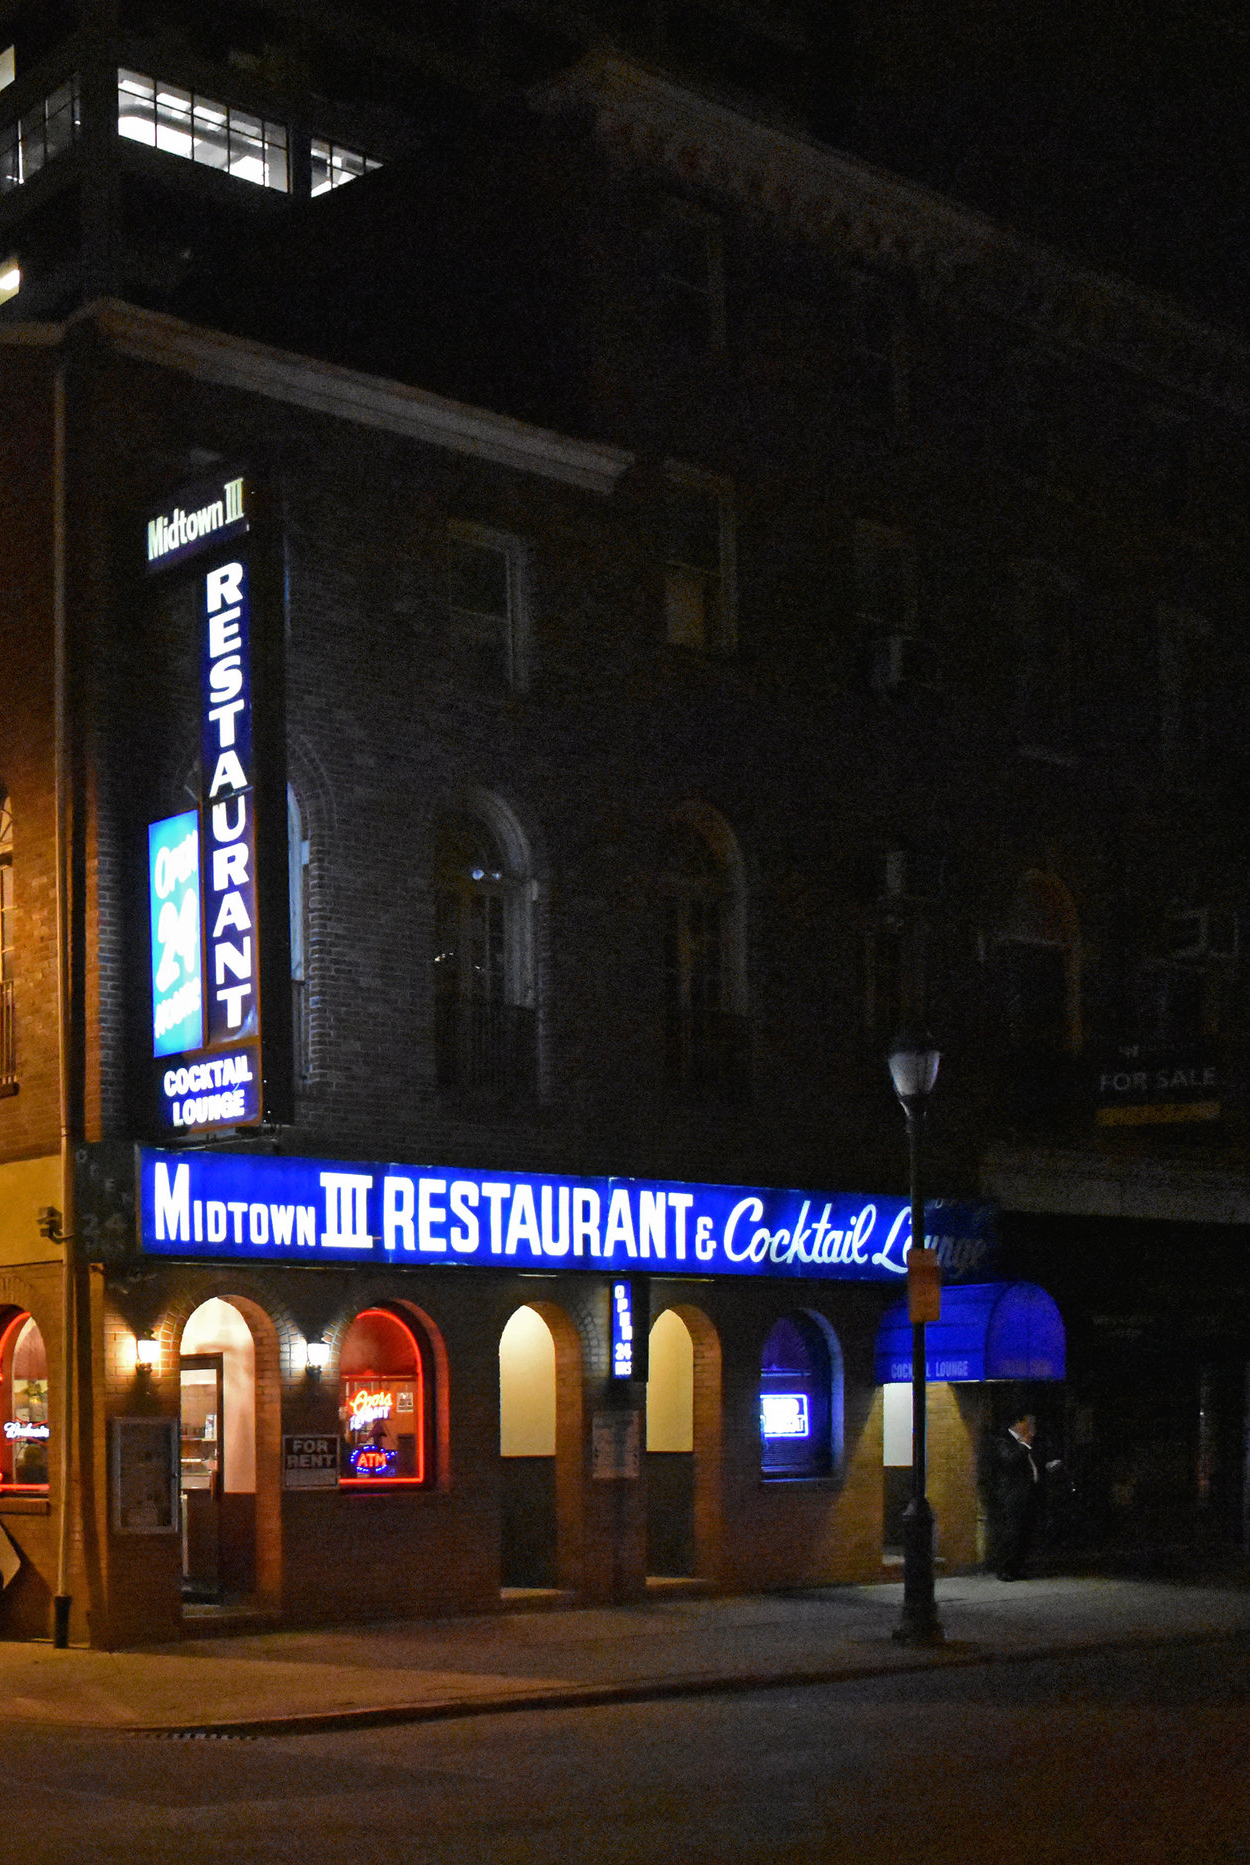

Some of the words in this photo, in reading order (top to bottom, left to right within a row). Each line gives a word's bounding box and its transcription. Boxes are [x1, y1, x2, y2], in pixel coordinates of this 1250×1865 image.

[148, 500, 224, 561] Midtown
[224, 477, 245, 525] III
[206, 562, 251, 1028] RESTAURANT
[156, 889, 197, 993] 24
[164, 1055, 253, 1097] COCKTAIL
[1100, 1072, 1148, 1092] FOR
[1156, 1066, 1217, 1089] SALE
[173, 1090, 245, 1127] LOUNGE
[319, 1171, 373, 1249] III
[382, 1175, 693, 1260] RESTAURANT
[695, 1216, 717, 1261] &
[723, 1197, 878, 1265] Cocktail
[891, 1362, 931, 1378] COCKL
[935, 1360, 968, 1377] LOUNGE
[350, 1390, 393, 1415] Coors
[286, 1454, 336, 1468] RENT
[292, 1440, 328, 1453] FOR
[357, 1452, 387, 1468] ATM
